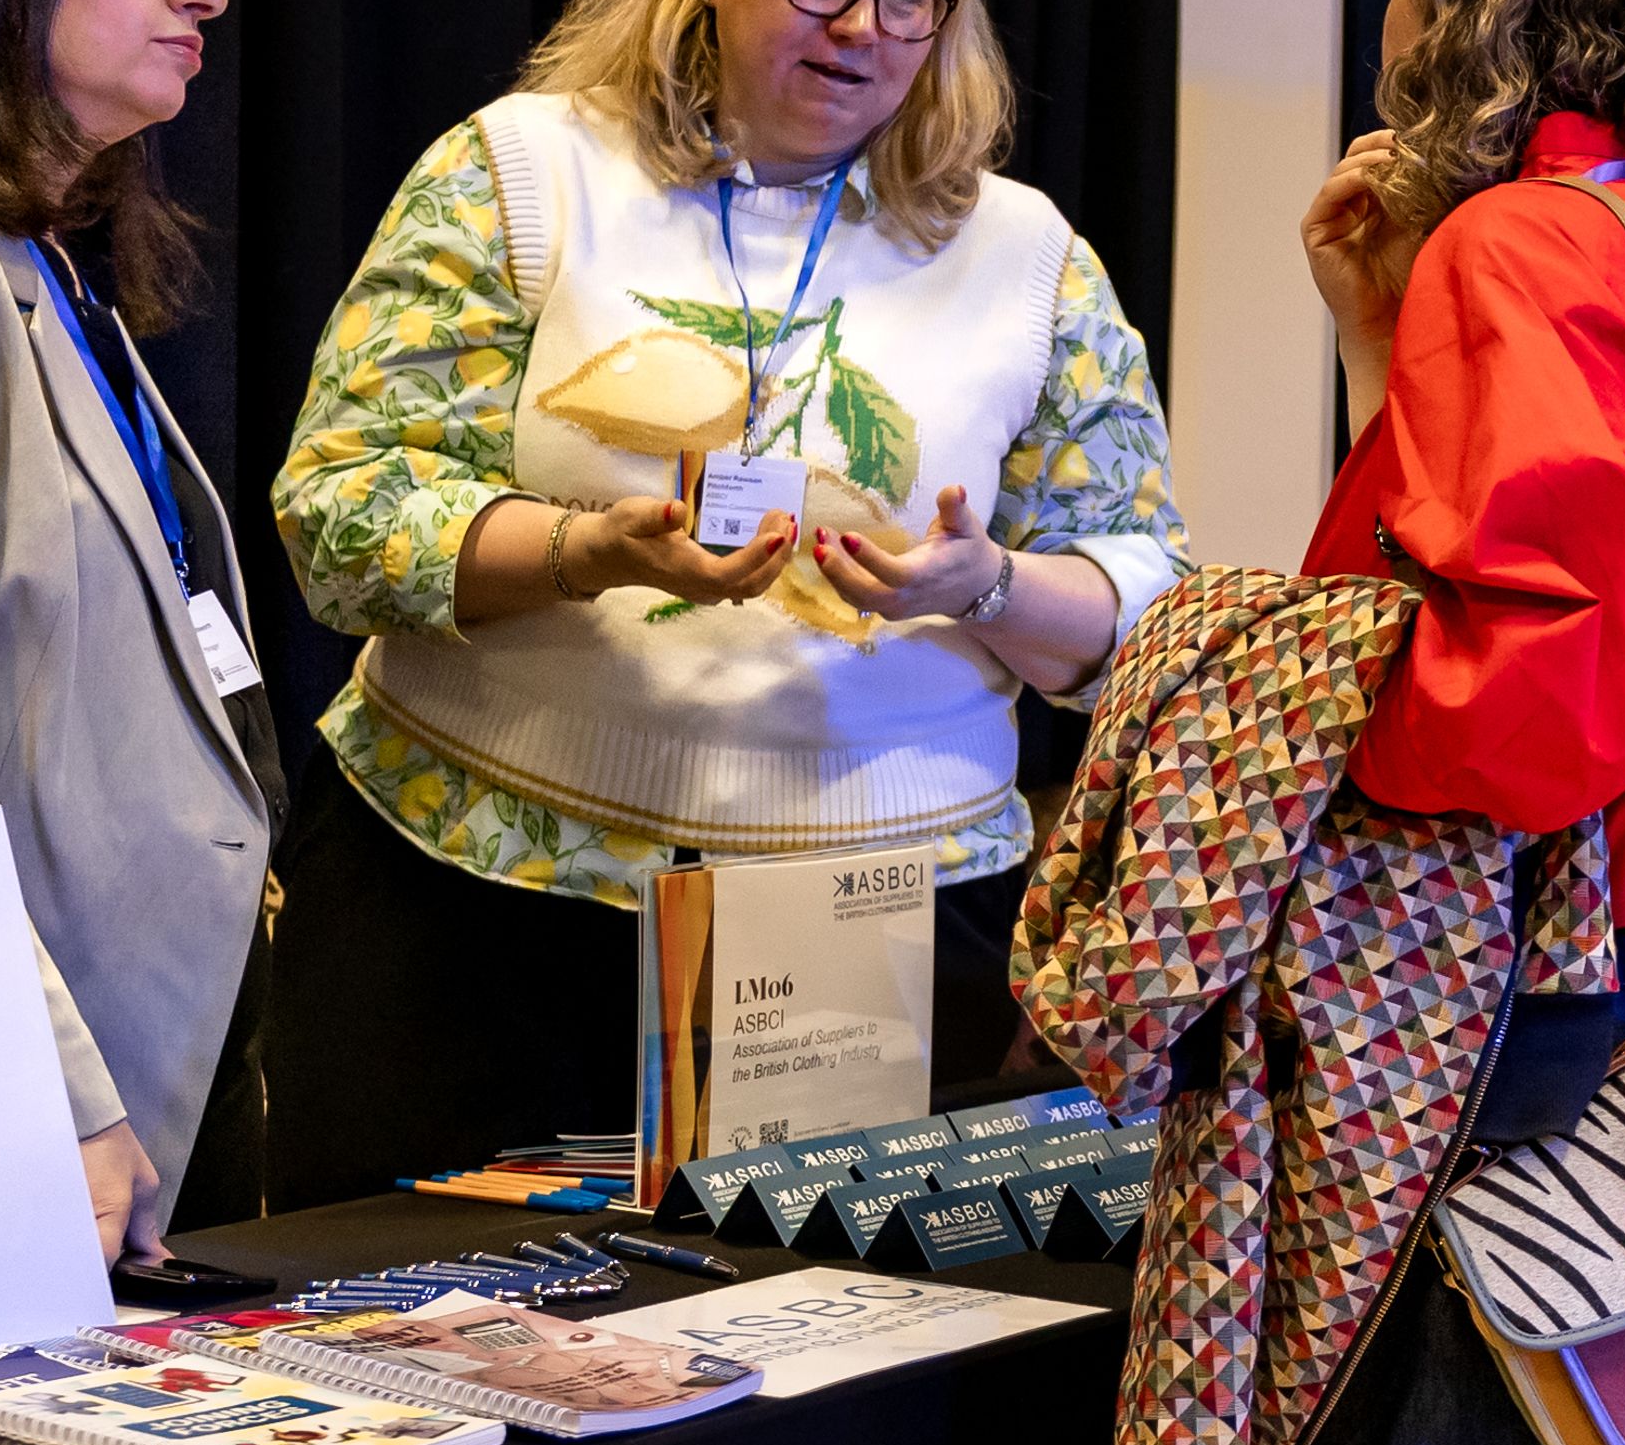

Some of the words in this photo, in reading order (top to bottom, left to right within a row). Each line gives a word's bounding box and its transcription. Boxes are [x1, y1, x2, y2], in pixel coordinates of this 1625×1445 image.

[857, 862, 923, 894] ASBCI
[733, 1008, 784, 1037] ASBCI
[732, 1036, 798, 1060] Association
[801, 1031, 813, 1048] of
[815, 1024, 864, 1047] Suppliers
[867, 1021, 877, 1035] to
[732, 1067, 751, 1083] the
[754, 1060, 789, 1080] British
[792, 1052, 837, 1072] Clothing
[840, 1043, 883, 1064] Industry
[985, 1113, 1031, 1138] ASBCI
[816, 1144, 869, 1166] ASBCI
[899, 1131, 950, 1153] ASBCI
[1111, 1181, 1151, 1204] ASBC
[941, 1200, 997, 1226] ASBCI
[802, 1327, 836, 1338] OF
[150, 1400, 291, 1431] JOINING
[170, 1406, 310, 1436] FORCES
